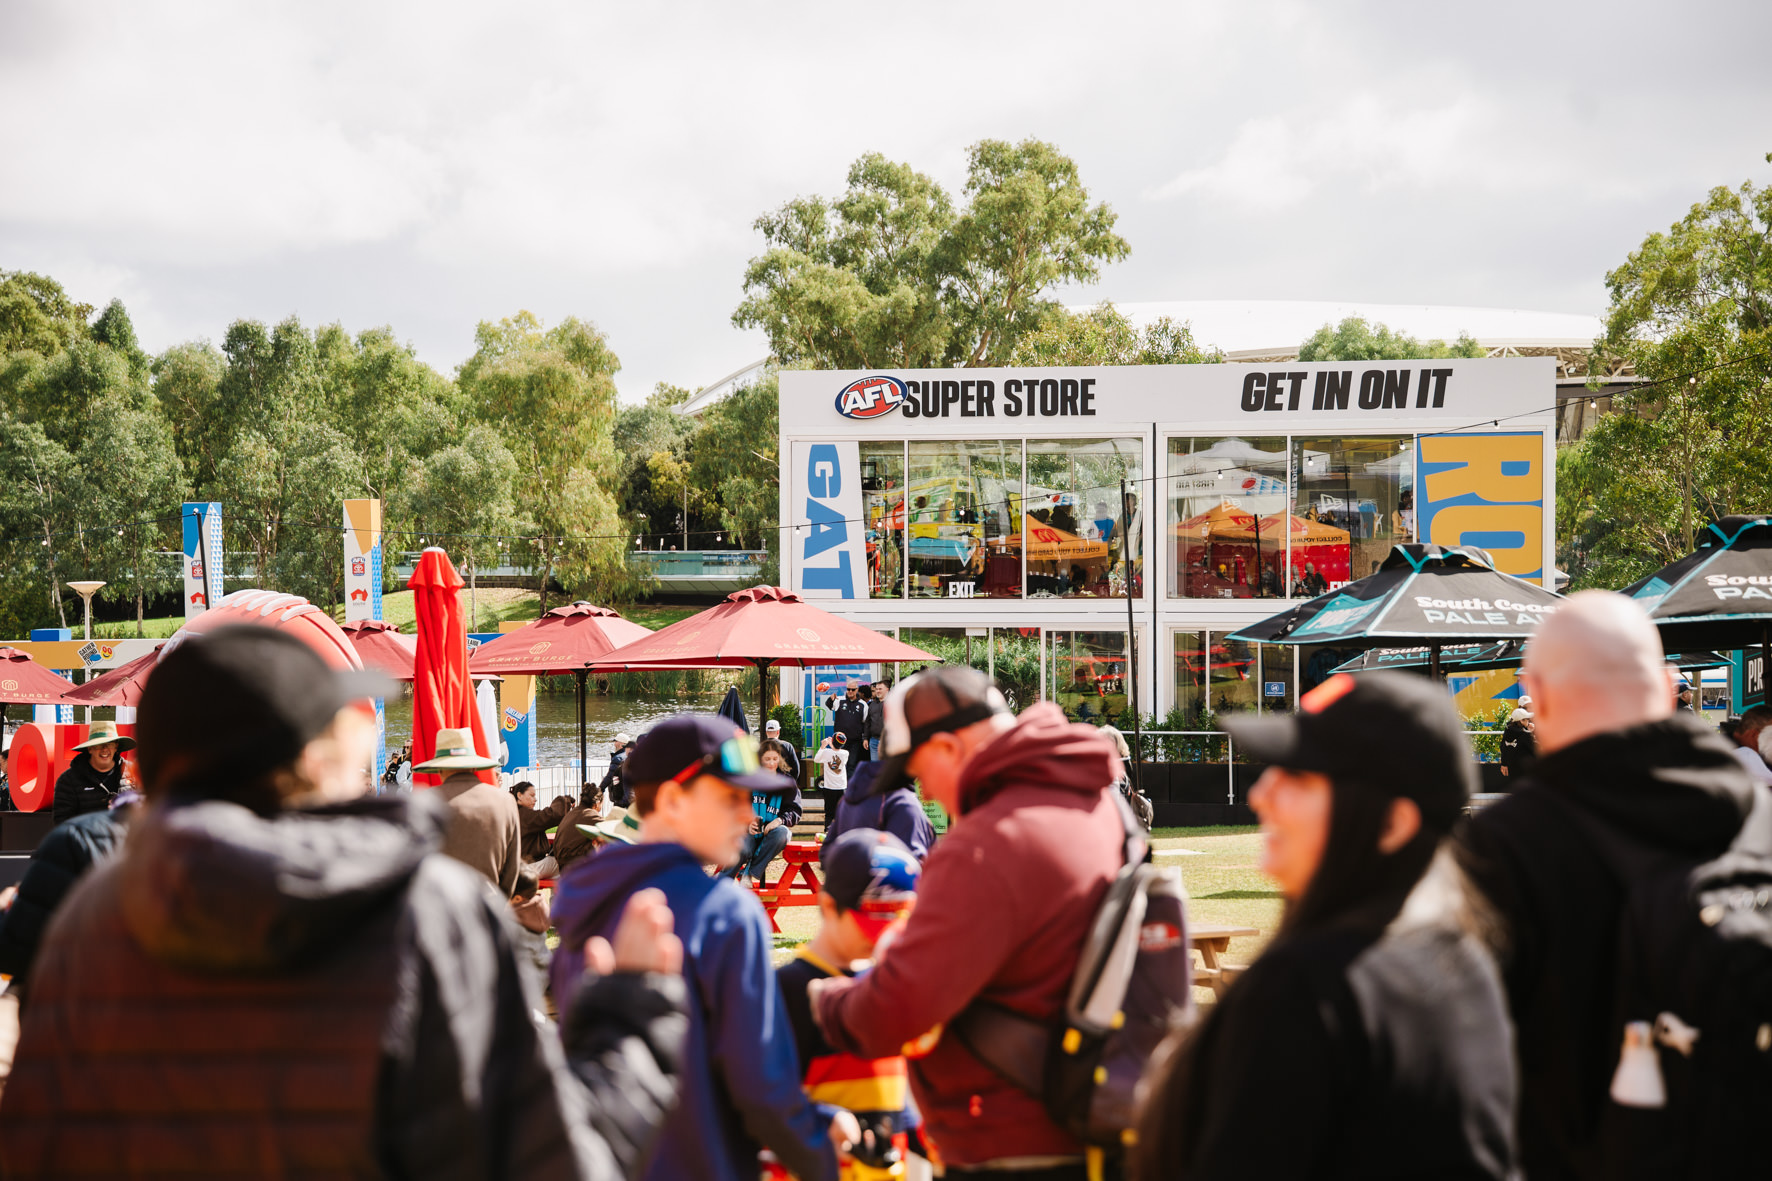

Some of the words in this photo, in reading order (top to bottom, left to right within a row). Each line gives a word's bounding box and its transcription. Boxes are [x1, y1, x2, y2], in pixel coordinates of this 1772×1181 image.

[902, 380, 995, 418] SUPER
[1003, 378, 1097, 417] STORE
[1241, 371, 1308, 412] GET
[1312, 370, 1353, 411] IN
[1358, 369, 1411, 410] ON
[1416, 368, 1453, 408] IT
[842, 383, 904, 415] AFL
[1704, 574, 1772, 588] Sou
[949, 581, 976, 599] EXIT
[1712, 586, 1772, 600] PA
[1414, 596, 1494, 610] South
[1494, 598, 1559, 613] Coas
[1423, 609, 1510, 625] PALE
